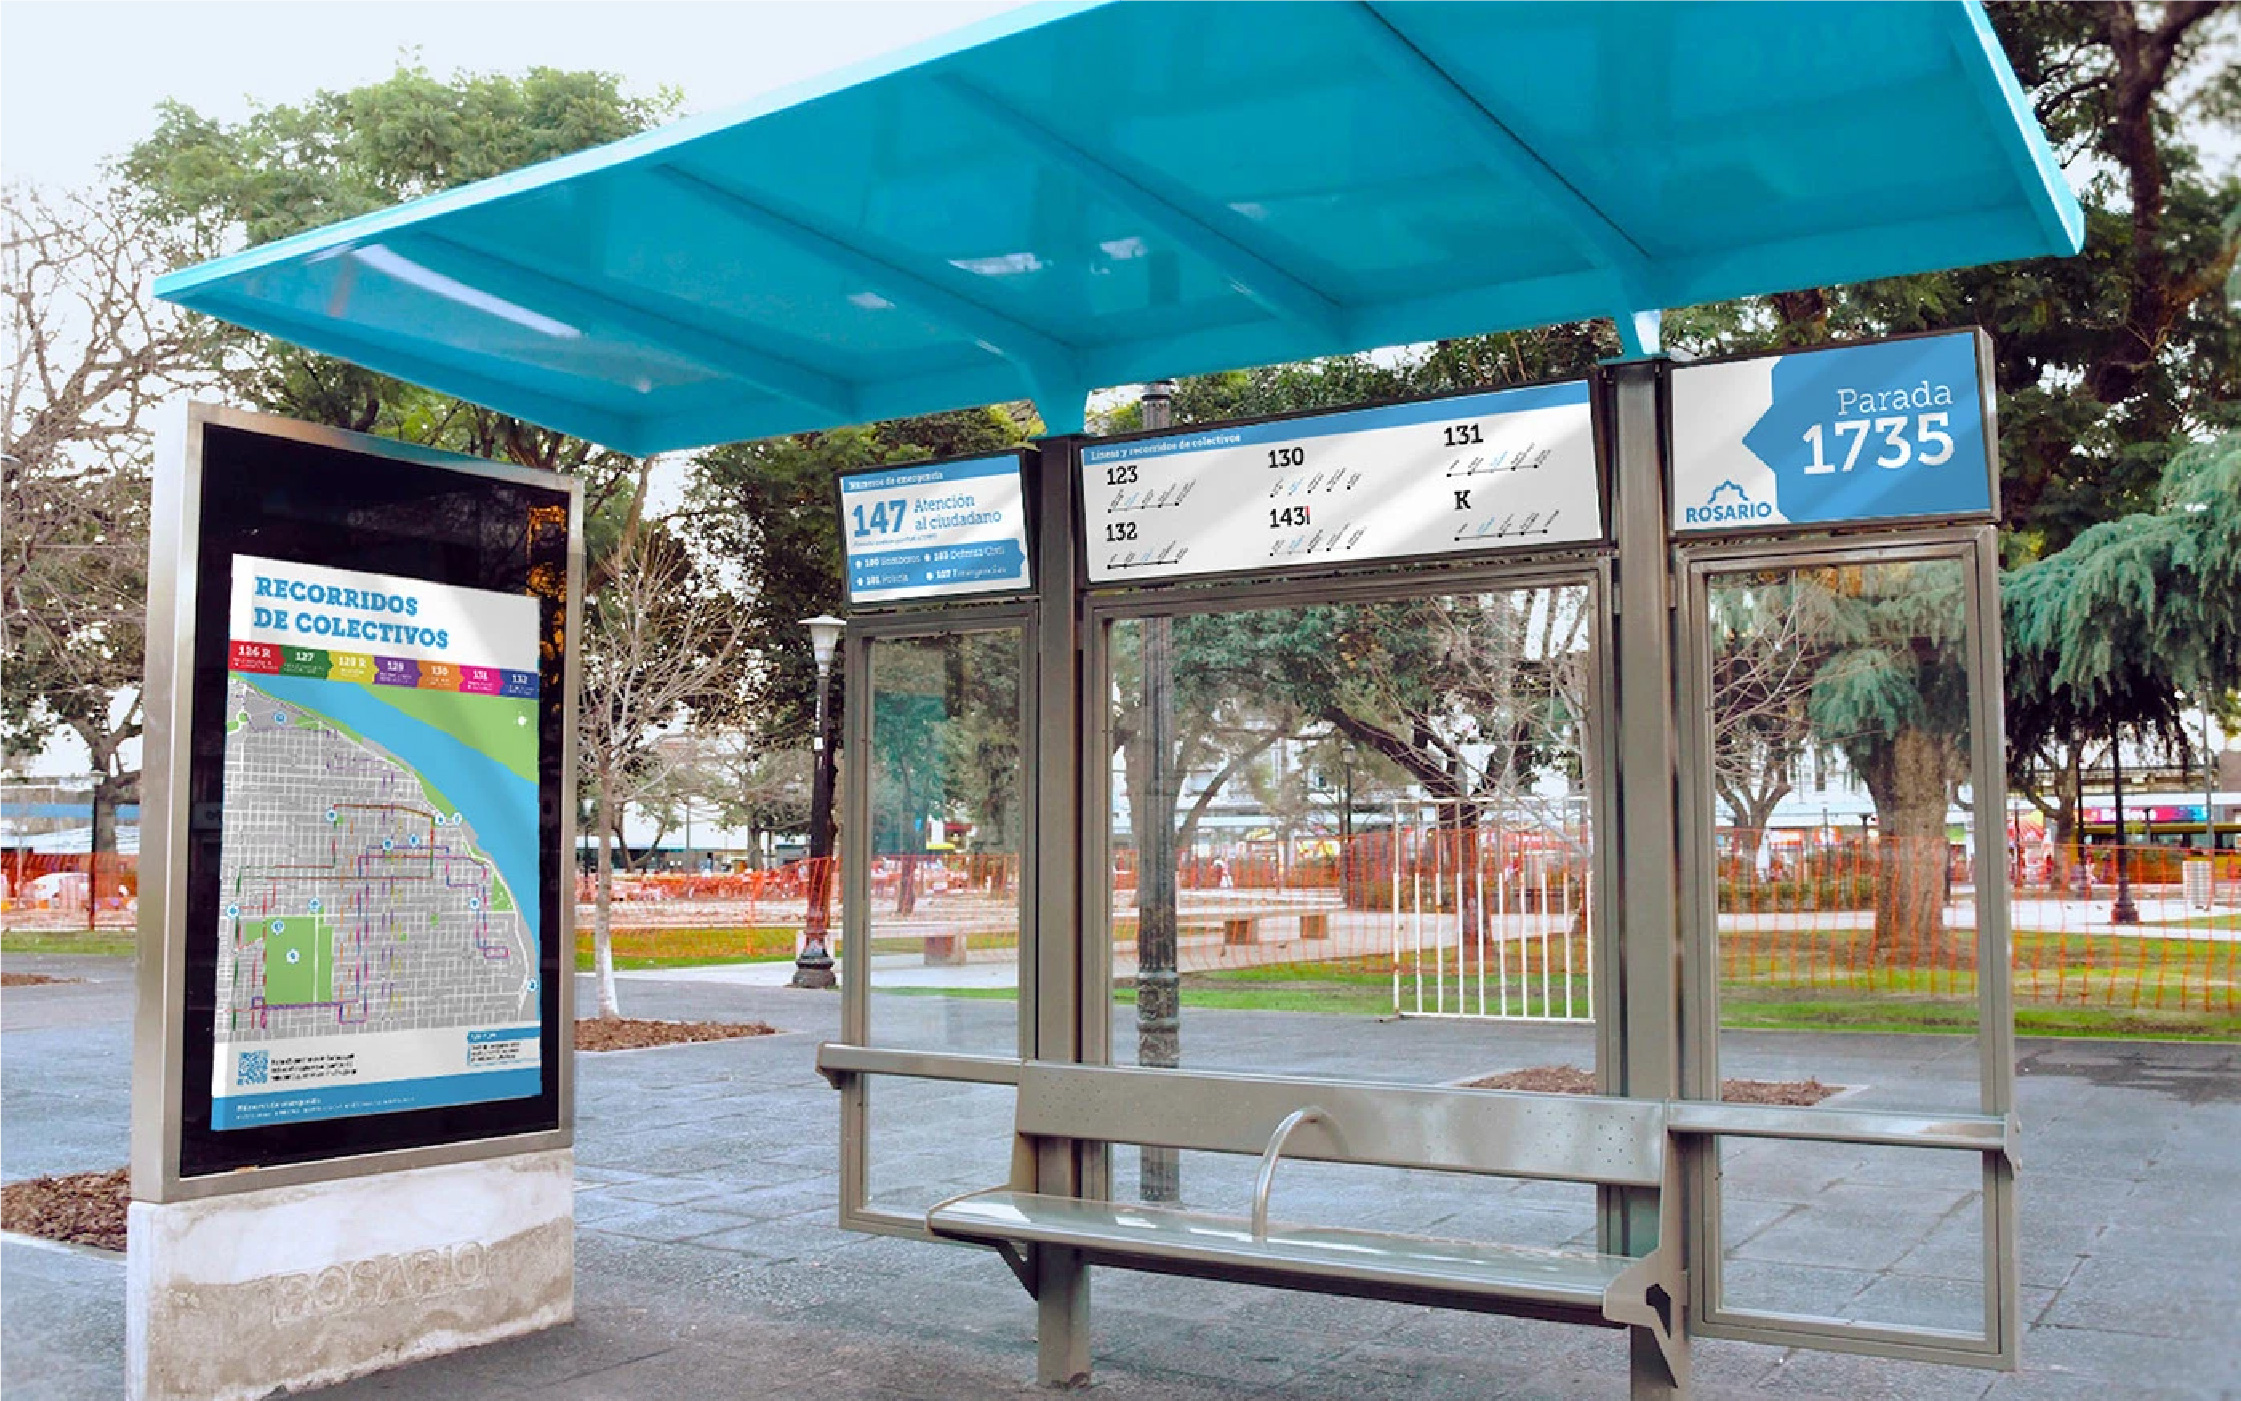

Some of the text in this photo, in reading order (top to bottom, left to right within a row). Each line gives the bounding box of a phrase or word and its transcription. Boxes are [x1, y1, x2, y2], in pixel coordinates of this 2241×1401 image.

[1836, 380, 1953, 415] Parada
[1179, 439, 1191, 449] de
[1192, 434, 1240, 448] colectivos
[1444, 423, 1484, 447] 131
[1802, 412, 1956, 475] 1735
[1268, 447, 1304, 469] 130
[1107, 465, 1138, 486] 123
[1454, 489, 1472, 510] K
[852, 493, 975, 538] 147 Atención
[915, 510, 1002, 531] al ciudadano
[1269, 506, 1305, 529] 143
[1685, 501, 1773, 524] ROSARIO
[1106, 522, 1138, 542] 132
[254, 576, 418, 617] RECORRIDOS
[253, 607, 449, 650] DE COLECTIVOS
